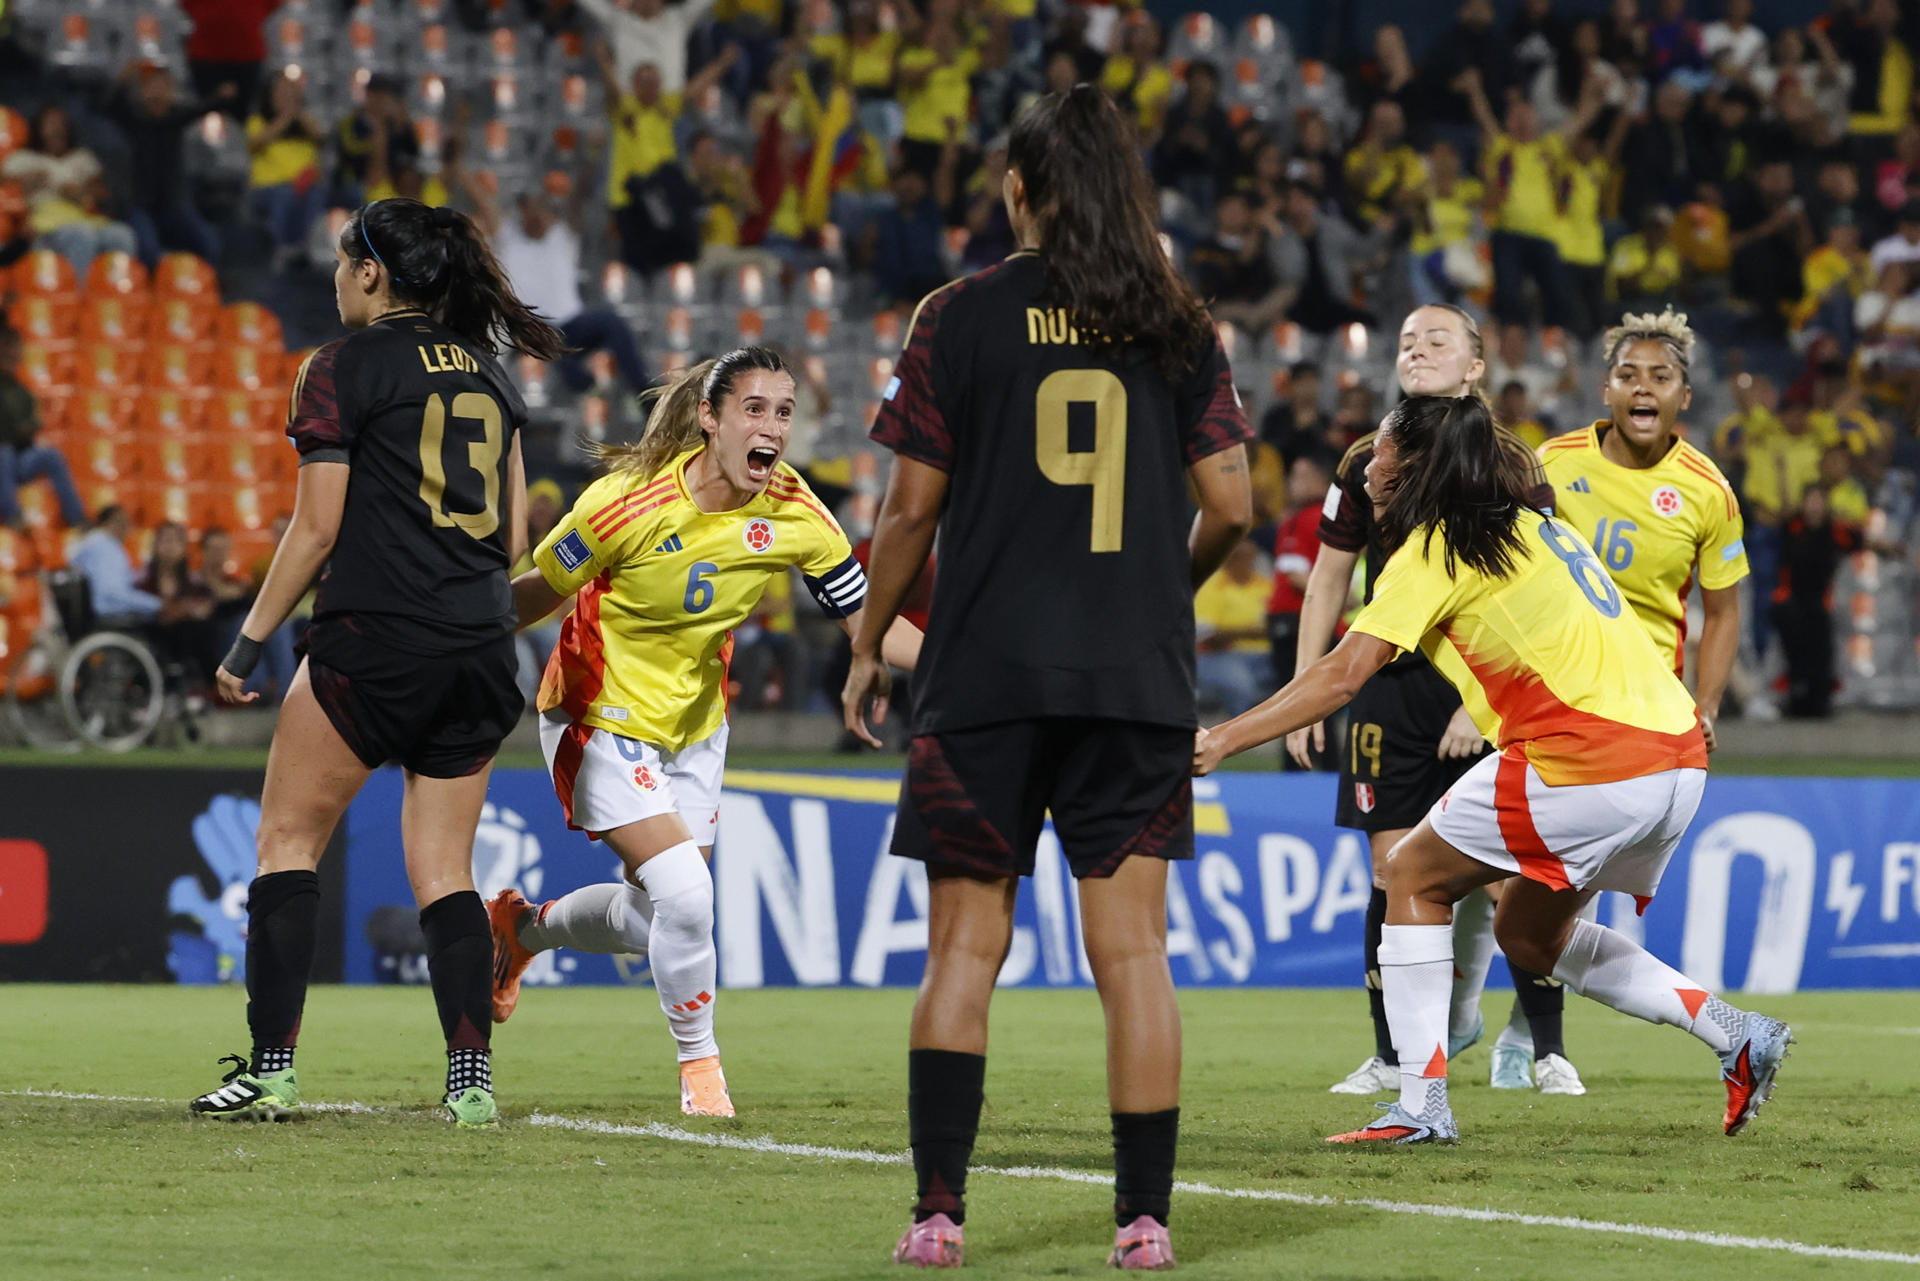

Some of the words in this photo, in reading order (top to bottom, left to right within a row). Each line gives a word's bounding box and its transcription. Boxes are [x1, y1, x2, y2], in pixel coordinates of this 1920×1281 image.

[419, 392, 503, 540] 13
[1035, 368, 1128, 553] 9
[1538, 519, 1621, 619] 8
[1593, 517, 1638, 571] 16
[683, 561, 718, 614] 6
[1351, 722, 1382, 778] 19
